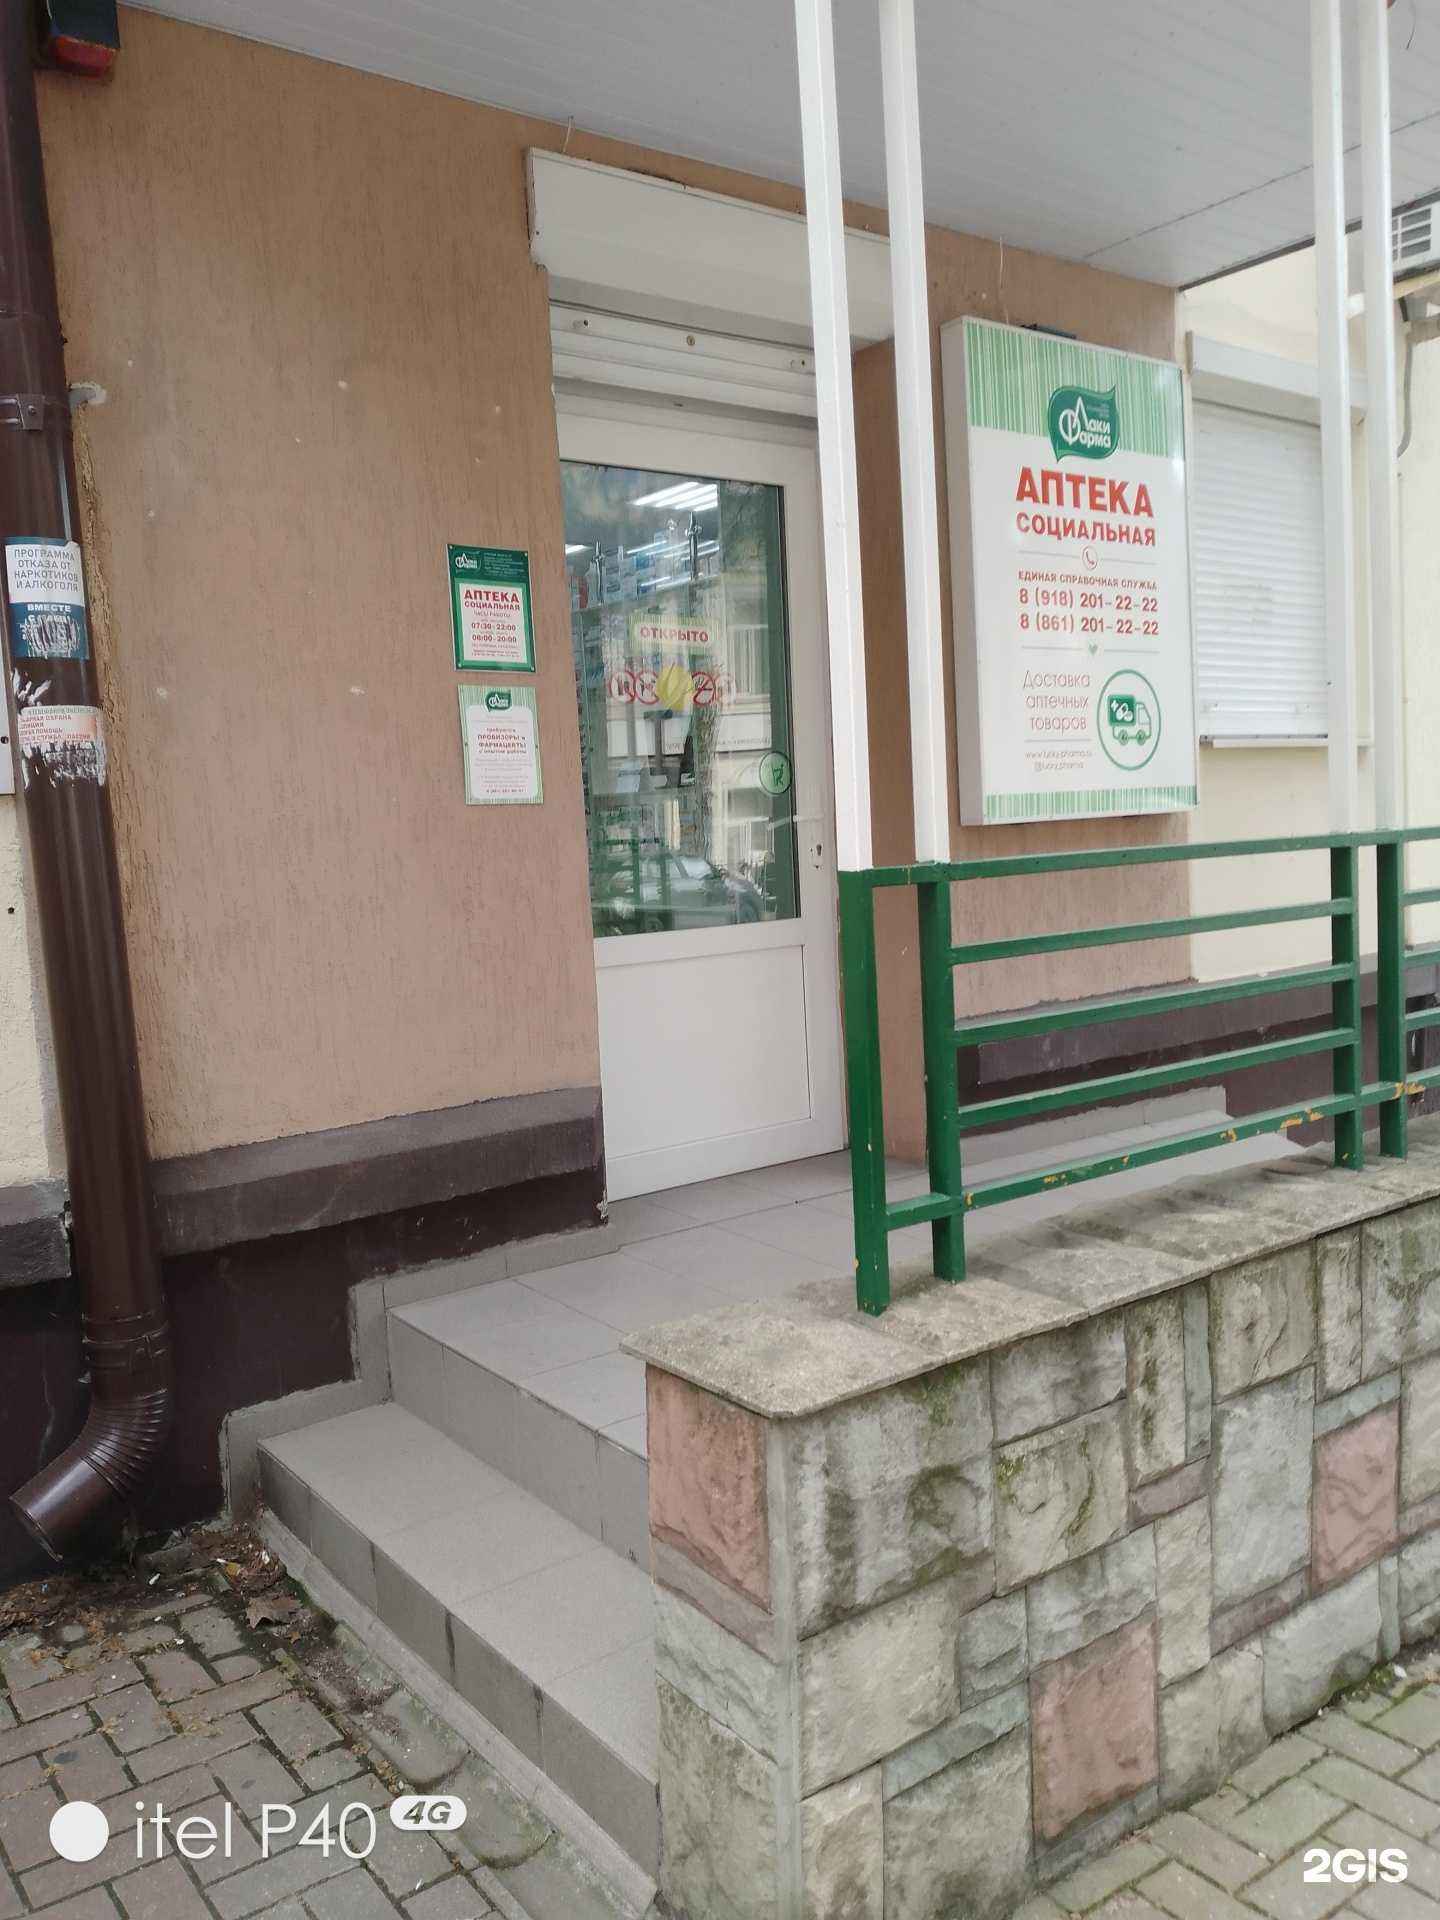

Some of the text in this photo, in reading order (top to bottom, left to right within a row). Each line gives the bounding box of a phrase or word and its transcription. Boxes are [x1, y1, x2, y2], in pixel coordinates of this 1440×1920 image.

[1072, 396, 1111, 434] Лаки
[1058, 408, 1112, 449] Фарма
[1015, 465, 1154, 519] АПТЕКА
[1016, 511, 1156, 547] СОЦИАЛЬНАЯ
[14, 548, 75, 561] ПРОГРАММА
[18, 559, 71, 570] ОТКАЗА ОТ
[14, 570, 79, 581] НАРКОТИКОВ
[1018, 570, 1158, 591] ЕДИНАЯ СПРАВОЧНАЯ СЛУЖБА
[16, 580, 78, 592] И АЛКОГОЛЯ
[464, 589, 520, 604] АПТЕКА
[1019, 588, 1029, 605] 8
[1035, 587, 1074, 609] (918)
[27, 603, 72, 613] ВМЕСТЕ
[464, 601, 520, 611] СОЦИАЛЬНАЯ
[1020, 613, 1030, 630] 8
[1036, 612, 1075, 634] (861)
[640, 626, 709, 643] ОТКРЫТО
[1023, 669, 1091, 690] Доставка
[1026, 695, 1089, 710] аптечных
[1029, 717, 1087, 736] товаров
